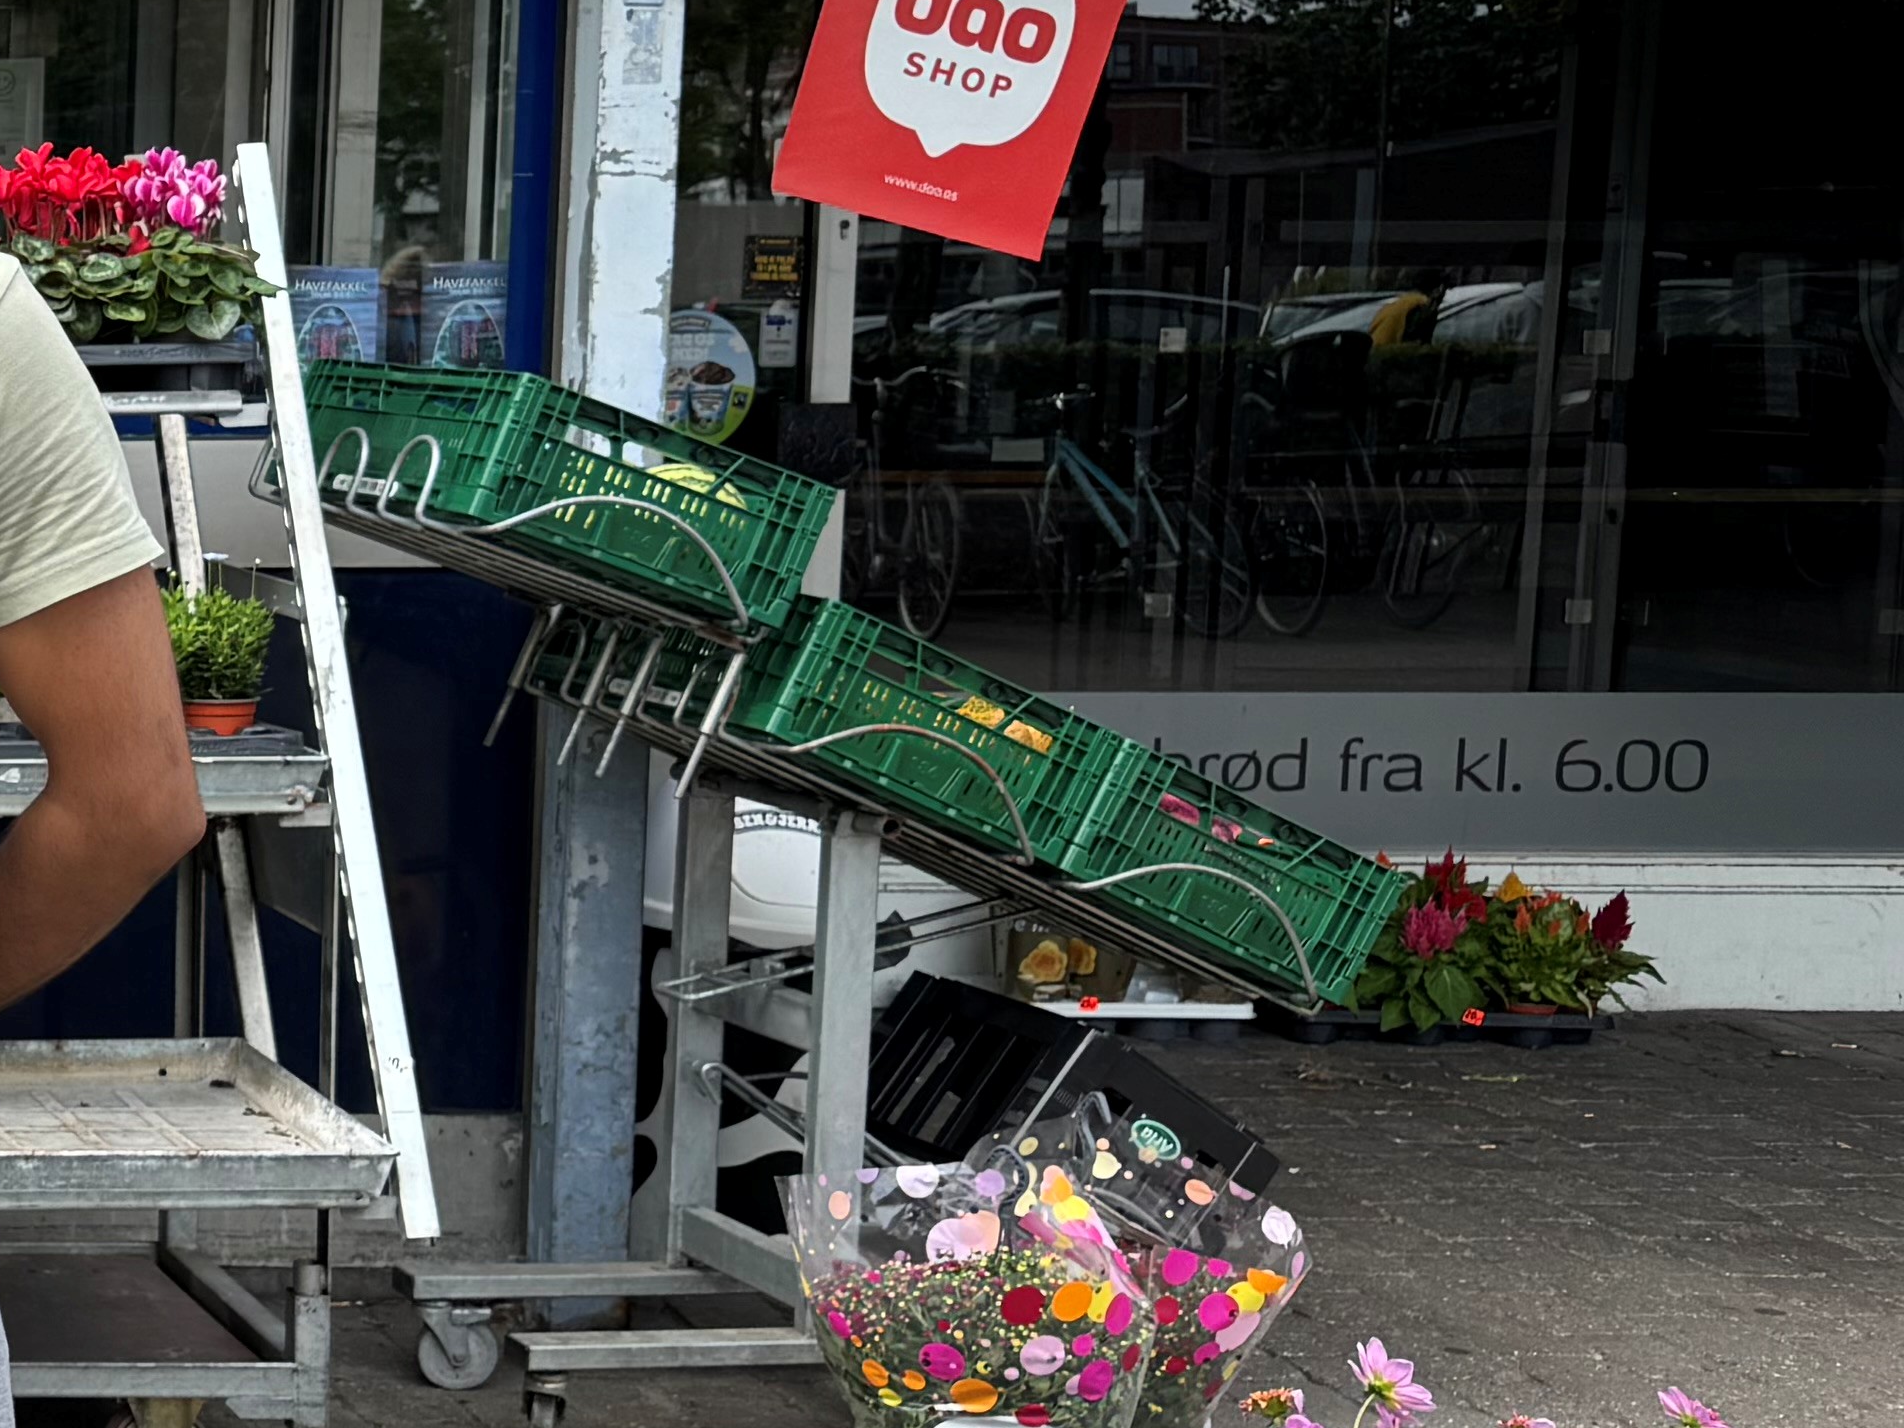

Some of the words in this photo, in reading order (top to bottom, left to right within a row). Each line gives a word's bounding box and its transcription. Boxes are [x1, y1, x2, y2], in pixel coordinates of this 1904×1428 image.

[903, 52, 1013, 99] SHOP
[1339, 738, 1423, 792] fra
[1455, 738, 1521, 793] kl.
[1555, 739, 1709, 794] 6.00
